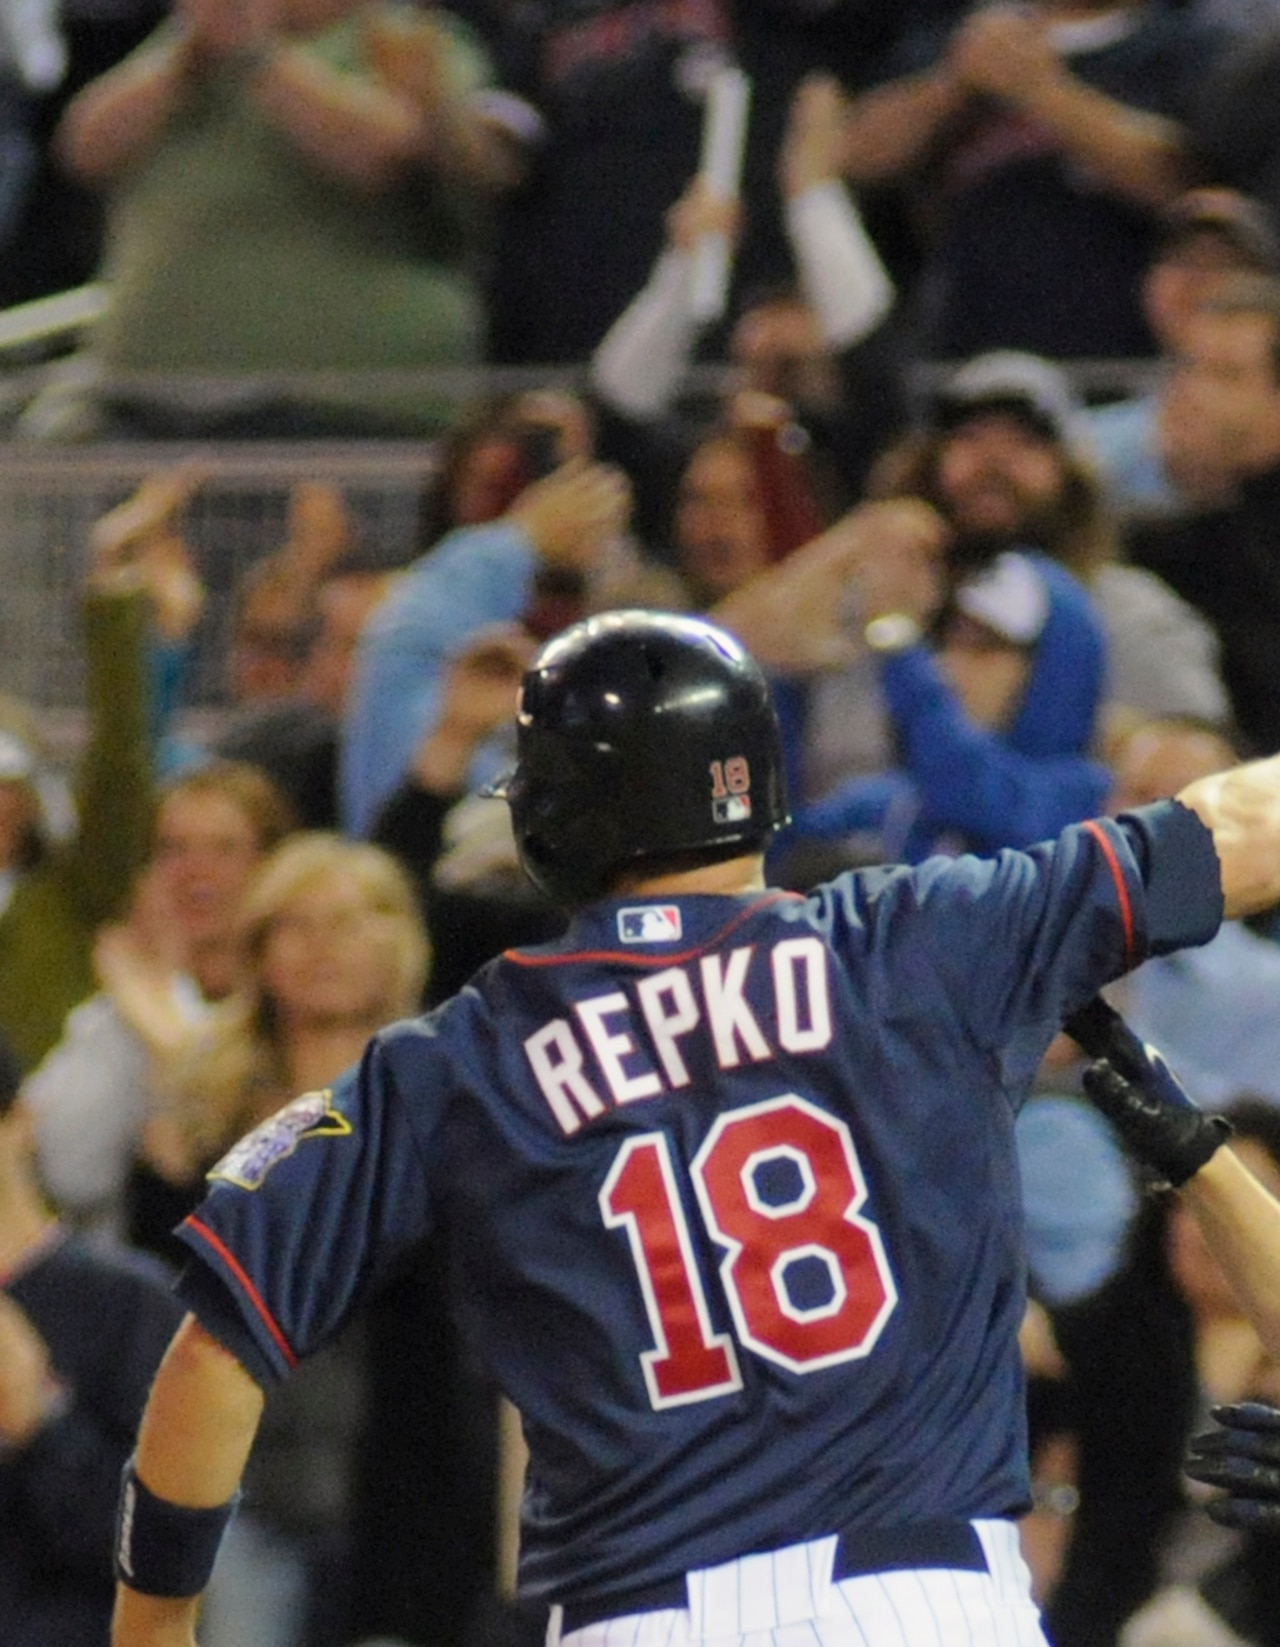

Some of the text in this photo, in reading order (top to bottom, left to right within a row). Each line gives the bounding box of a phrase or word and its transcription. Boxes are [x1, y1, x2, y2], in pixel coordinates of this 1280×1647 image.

[709, 756, 751, 798] 18
[523, 936, 833, 1137] REPKO
[597, 1092, 899, 1412] 18
